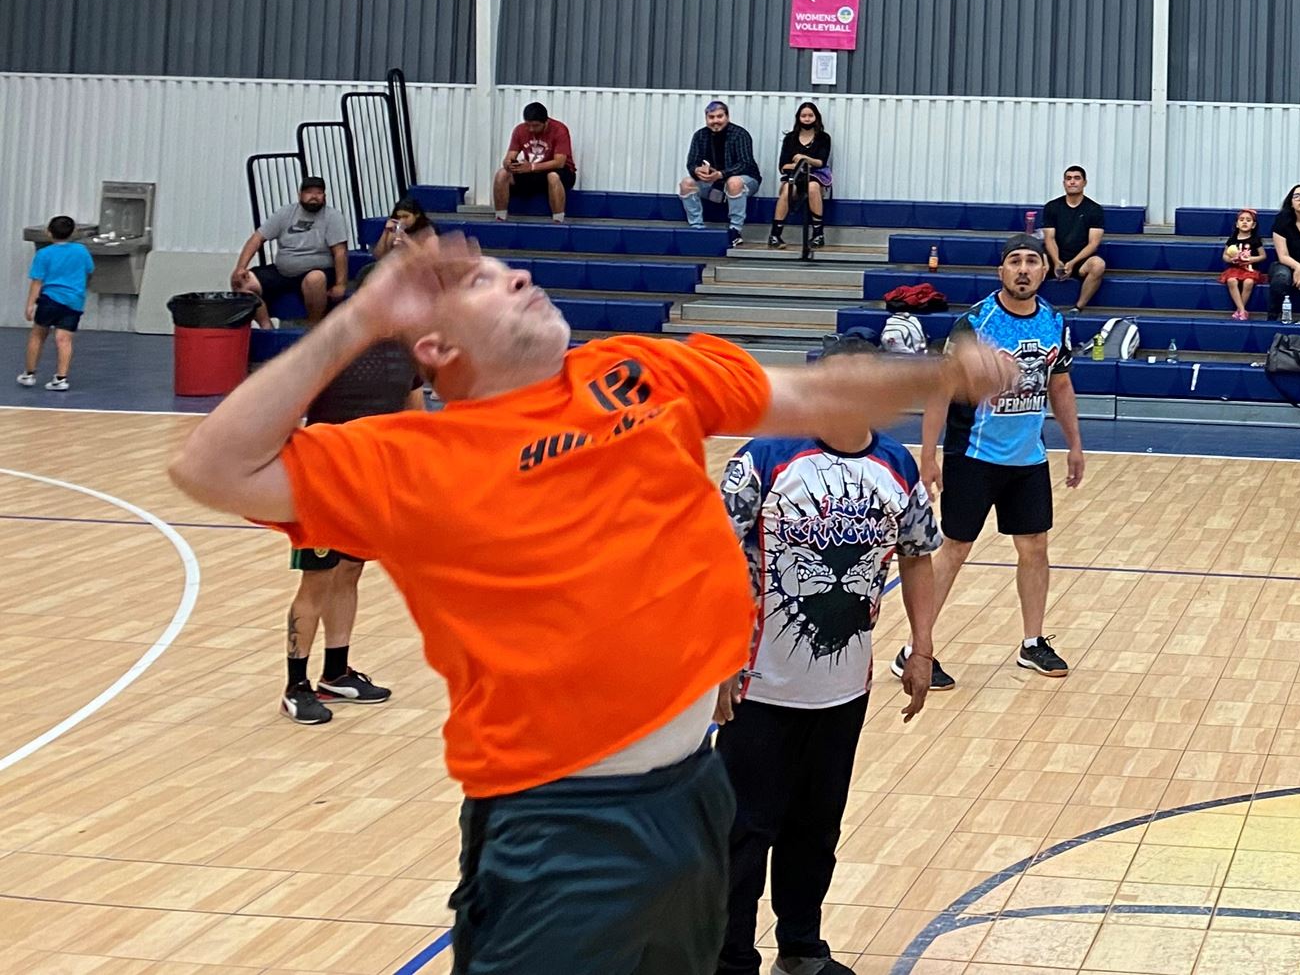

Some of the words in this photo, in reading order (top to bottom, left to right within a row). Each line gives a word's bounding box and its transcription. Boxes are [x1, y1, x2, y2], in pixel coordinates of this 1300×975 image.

[796, 13, 837, 22] WOMENS
[795, 22, 852, 32] VOLLEYBALL
[1022, 343, 1038, 352] LOS
[1190, 363, 1201, 391] 1
